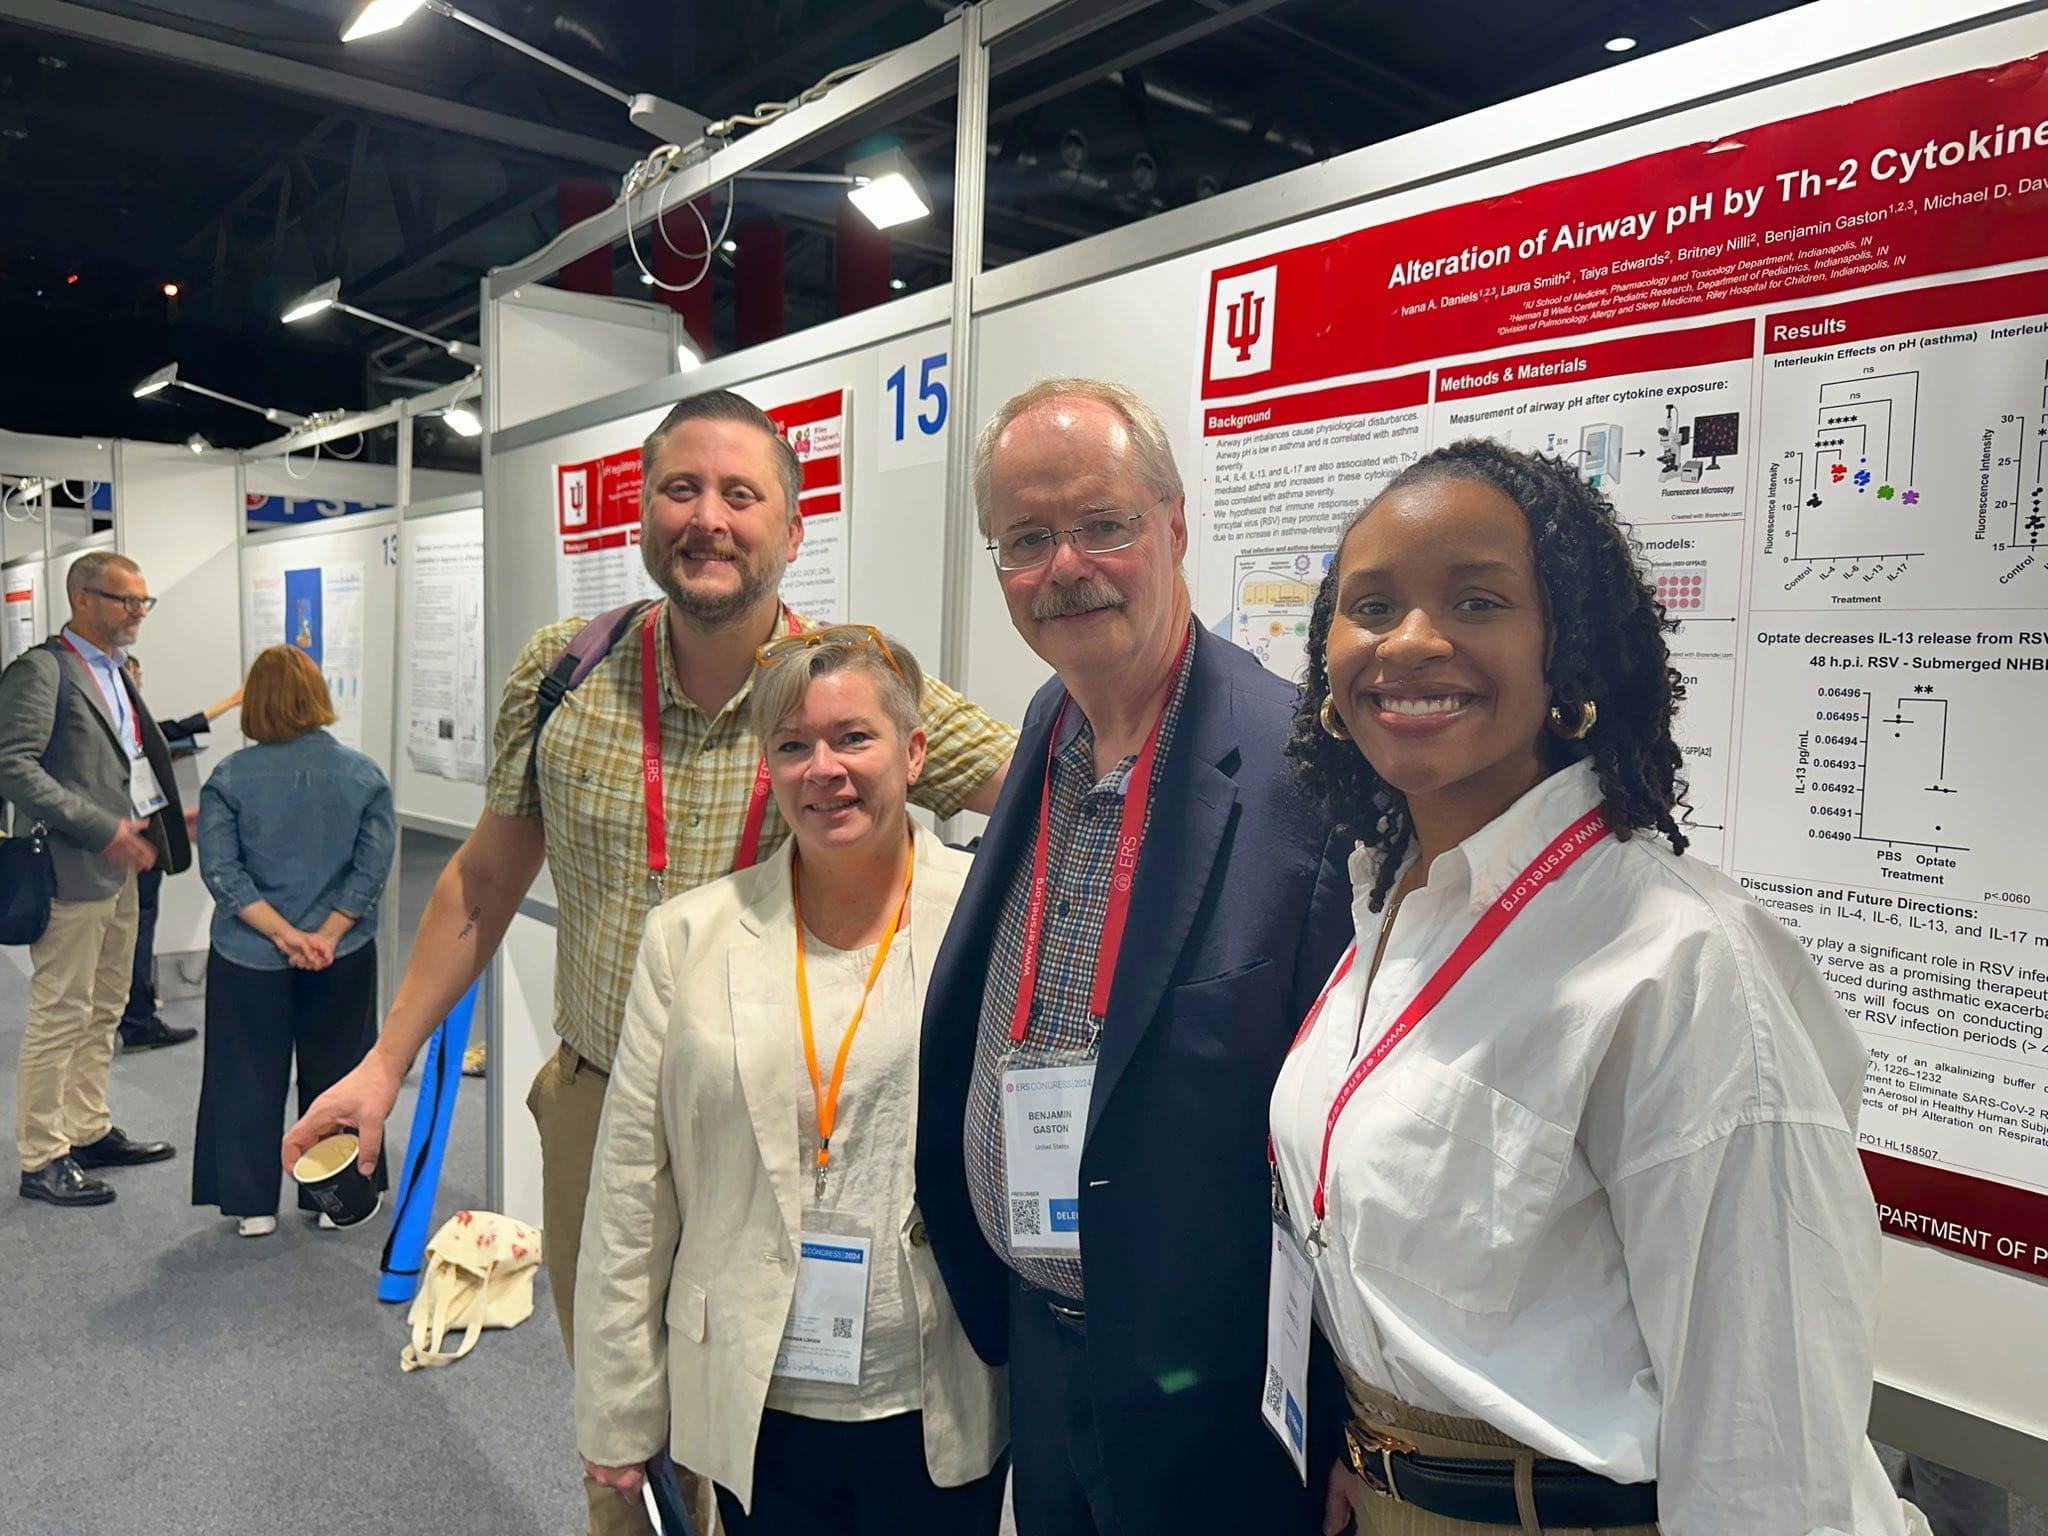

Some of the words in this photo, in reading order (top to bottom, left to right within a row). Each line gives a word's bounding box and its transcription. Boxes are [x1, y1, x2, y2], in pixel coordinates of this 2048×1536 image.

[1388, 244, 1510, 288] Alteration
[1518, 229, 1548, 258] of
[1552, 209, 1656, 253] Airway
[1666, 192, 1713, 234] pH
[1724, 185, 1766, 219] by
[1776, 159, 1858, 202] Th-2
[1401, 303, 1427, 318] Ivana
[1501, 281, 1531, 300] Laura
[1579, 266, 1609, 286] Taiya
[1677, 242, 1724, 262] Britney
[1765, 220, 1831, 244] Benjamin
[1923, 187, 1988, 212] Michael
[1994, 183, 2012, 199] D.
[1537, 295, 1562, 309] School
[1563, 292, 1572, 303] of
[1573, 287, 1609, 303] Medicine,
[1610, 276, 1670, 296] Pharmacology
[1671, 273, 1689, 286] and
[1690, 263, 1737, 284] Toxicology
[1738, 253, 1795, 273] Department,
[1797, 241, 1857, 264] Indianapolis,
[1860, 236, 1873, 249] IN
[1773, 318, 1847, 342] Results
[1774, 352, 1834, 368] Interleukin
[1837, 345, 1876, 360] Effects
[1879, 342, 1895, 353] on
[1898, 338, 1917, 353] pH
[1919, 330, 1978, 349] (asthma)
[1440, 371, 1499, 392] Methods
[1503, 368, 1513, 382] &
[1517, 359, 1587, 380] Materials
[1863, 365, 1875, 374] ns
[885, 352, 948, 441] 15
[1449, 406, 1514, 425] Measurement
[1516, 403, 1528, 415] of
[1529, 400, 1565, 415] airway
[1568, 396, 1583, 413] pH
[1586, 392, 1610, 407] after
[1612, 387, 1663, 404] cytokine
[1666, 380, 1729, 397] exposure:
[1850, 391, 1861, 400] ns
[1209, 408, 1271, 429] Background
[2001, 414, 2014, 423] 30
[1998, 457, 2011, 466] 25
[1661, 487, 1699, 497] Fluorescence
[1700, 486, 1734, 497] Microscopy
[1768, 462, 1780, 498] Intensity
[1782, 503, 1792, 511] 10
[1995, 500, 2007, 509] 20
[1764, 499, 1777, 555] Fluorescence
[1646, 538, 1696, 550] models:
[1992, 543, 2005, 552] 15
[1784, 566, 1812, 591] Control
[1819, 565, 1836, 581] IL-4
[1842, 565, 1859, 580] IL-6
[1862, 565, 1884, 583] IL-13
[1886, 563, 1909, 582] IL-17
[1999, 555, 2035, 585] Control
[1831, 595, 1881, 604] Treatment
[1757, 631, 1801, 645] Optate
[1803, 632, 1874, 645] decreases
[1878, 631, 1914, 645] IL-13
[1917, 632, 1972, 645] release
[1976, 631, 2013, 645] from
[1809, 656, 1826, 668] 48
[1829, 656, 1864, 671] h.p.i.
[1867, 656, 1899, 668] RSV
[1912, 656, 2001, 673] Submerged
[1817, 687, 1861, 699] 0.06496
[1816, 711, 1860, 722] 0.06495
[1814, 735, 1858, 746] 0.06494
[647, 759, 659, 783] ERS
[1813, 759, 1856, 770] 0.06493
[1811, 782, 1855, 794] 0.06492
[1810, 806, 1853, 817] 0.06491
[1808, 829, 1852, 841] 0.06490
[1119, 835, 1137, 869] ERS
[1877, 850, 1902, 862] PBS
[1916, 854, 1956, 869] Optate
[1880, 867, 1944, 885] Treatment
[1740, 877, 1814, 898] Discussion
[1817, 887, 1844, 902] and
[1846, 890, 1893, 909] Future
[1897, 897, 1978, 921] Directions:
[1023, 876, 1044, 977] www.ersnet.org
[1819, 903, 1832, 917] in
[1837, 905, 1866, 923] IL-4,
[1872, 911, 1903, 928] IL-6,
[1909, 915, 1949, 935] IL-13,
[1954, 921, 1982, 938] and
[1988, 926, 2028, 945] IL-17
[1816, 935, 1844, 954] play
[1859, 943, 1929, 969] significant
[1931, 952, 1960, 969] role
[1962, 955, 1976, 971] in
[1979, 959, 2014, 978] RSV
[1828, 955, 1865, 971] serve
[1868, 961, 1886, 974] as
[1903, 966, 1971, 991] promising
[1865, 976, 1909, 997] during
[1912, 983, 1981, 1008] asthmatic
[1863, 993, 1886, 1008] will
[1892, 998, 1929, 1017] focus
[1937, 1006, 1955, 1020] on
[1963, 1010, 2043, 1038] conducting
[1865, 1009, 1897, 1029] RSV
[1900, 1016, 1959, 1039] infection
[1963, 1028, 2017, 1050] periods
[1327, 1021, 1407, 1131] www.ersnet.org
[1896, 1053, 1908, 1065] of
[1914, 1058, 1928, 1068] an
[1935, 1059, 1995, 1084] alkalinizing
[2003, 1072, 2036, 1091] buffer
[1880, 1086, 1918, 1107] Aerosol
[1920, 1096, 1929, 1108] in
[1932, 1099, 1974, 1126] Healthy
[1977, 1109, 2019, 1129] Human
[1895, 1078, 1906, 1090] to
[1909, 1079, 1959, 1102] Eliminate
[1963, 1088, 2036, 1117] SARS-CoV-2
[1028, 1109, 1072, 1120] BENJAMIN
[1887, 1101, 1899, 1113] of
[1902, 1105, 1918, 1119] pH
[1922, 1109, 1975, 1131] Alteration
[1978, 1122, 1993, 1134] on
[1033, 1124, 1069, 1134] GASTON
[1875, 1202, 1992, 1251] PARTMENT
[1996, 1236, 2026, 1260] OF
